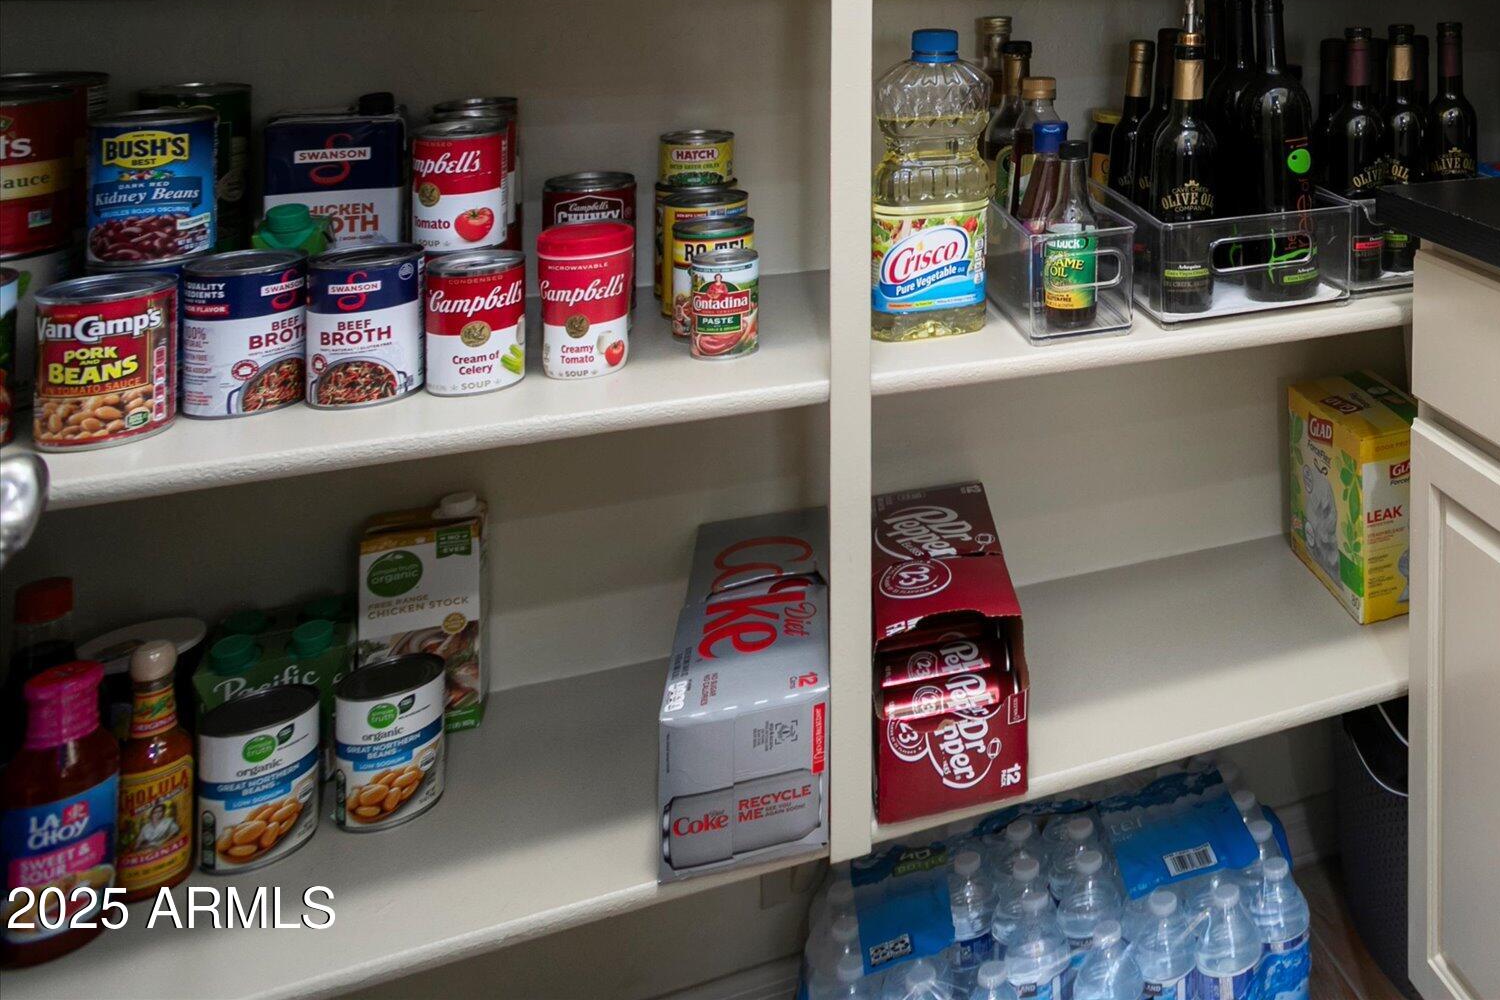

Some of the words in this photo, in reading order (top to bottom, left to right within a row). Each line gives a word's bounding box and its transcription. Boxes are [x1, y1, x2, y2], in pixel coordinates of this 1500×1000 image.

[105, 136, 187, 161] BUSH'S
[298, 149, 367, 161] SWANSON
[676, 149, 715, 160] HATCH
[131, 158, 157, 166] BEST
[1391, 163, 1409, 180] OIL
[118, 182, 145, 190] DARK
[95, 191, 147, 206] Kidney
[151, 187, 200, 201] Beans
[1161, 191, 1199, 210] OLIVE
[568, 201, 609, 213] Campbell's
[1174, 204, 1206, 213] COMPANY
[418, 239, 440, 248] SOUP
[547, 262, 609, 272] MICROWAVABLE
[1051, 266, 1068, 277] OIL
[330, 282, 379, 293] SWANSON
[448, 275, 504, 285] CONDENSED
[896, 281, 915, 296] Pure
[916, 264, 957, 287] Vegetable
[430, 280, 522, 317] Campbell's
[539, 273, 625, 307] Campbell's
[693, 295, 748, 310] Contadina
[271, 315, 300, 331] BEEF
[337, 319, 372, 332] BEEF
[702, 316, 734, 325] PASTE
[320, 325, 392, 346] BROTH
[63, 346, 118, 361] PORK
[452, 353, 486, 366] Cream
[488, 350, 500, 360] of
[560, 344, 594, 355] Creamy
[79, 358, 100, 366] AND
[560, 354, 595, 365] Tomato
[49, 354, 139, 385] BEANS
[458, 363, 493, 377] Celery
[564, 369, 590, 378] SOUP
[57, 384, 100, 394] TOMATO
[105, 377, 143, 391] SAUCE
[460, 379, 492, 391] SOUP
[1309, 418, 1333, 440] GLAD
[1366, 505, 1403, 524] LEAK
[883, 505, 959, 558] Pepper
[925, 519, 973, 542] Dr
[370, 569, 420, 586] organic
[898, 566, 930, 586] 23
[368, 603, 425, 620] CHICKEN
[429, 596, 469, 609] STOCK
[783, 601, 818, 640] Diet
[798, 671, 819, 688] 12
[346, 744, 373, 754] GREAT
[373, 731, 422, 751] NORTHERN
[361, 726, 405, 743] organic
[956, 718, 988, 754] Dr
[366, 748, 397, 760] BEANS
[235, 757, 284, 778] organic
[1005, 762, 1022, 786] 12
[216, 782, 246, 793] GREAT
[241, 783, 275, 796] BEANS
[738, 784, 812, 811] RECYCLE
[738, 806, 764, 823] ME
[765, 808, 785, 818] AGAIN
[29, 812, 61, 835] LA
[673, 813, 729, 839] Coke
[27, 816, 90, 850] CHOY
[20, 848, 76, 871] SWEET
[79, 841, 91, 854] &
[19, 864, 67, 886] SOUR
